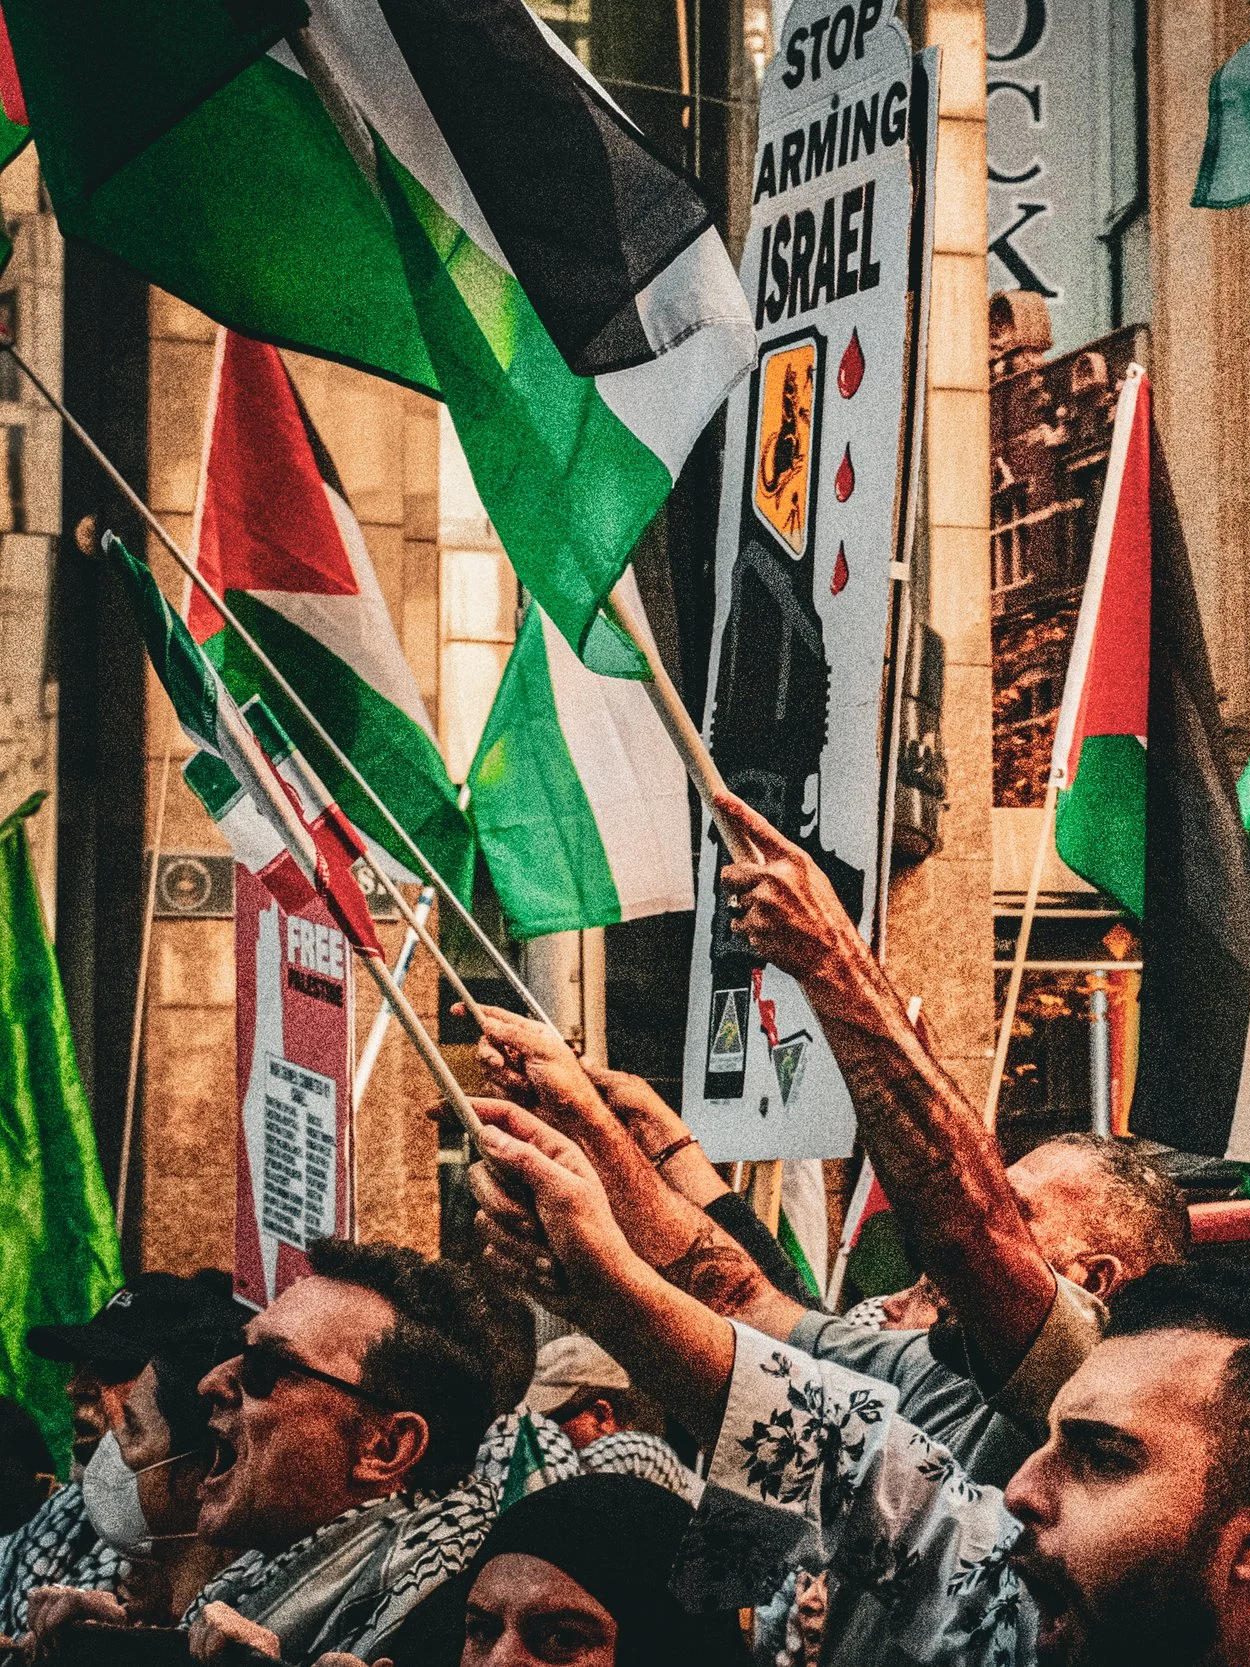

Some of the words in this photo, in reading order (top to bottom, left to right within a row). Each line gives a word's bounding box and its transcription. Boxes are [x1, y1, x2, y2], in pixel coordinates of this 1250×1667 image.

[781, 0, 882, 90] STOP
[754, 81, 908, 202] ARMING
[755, 180, 881, 331] ISRAEL
[287, 914, 344, 980] FREE
